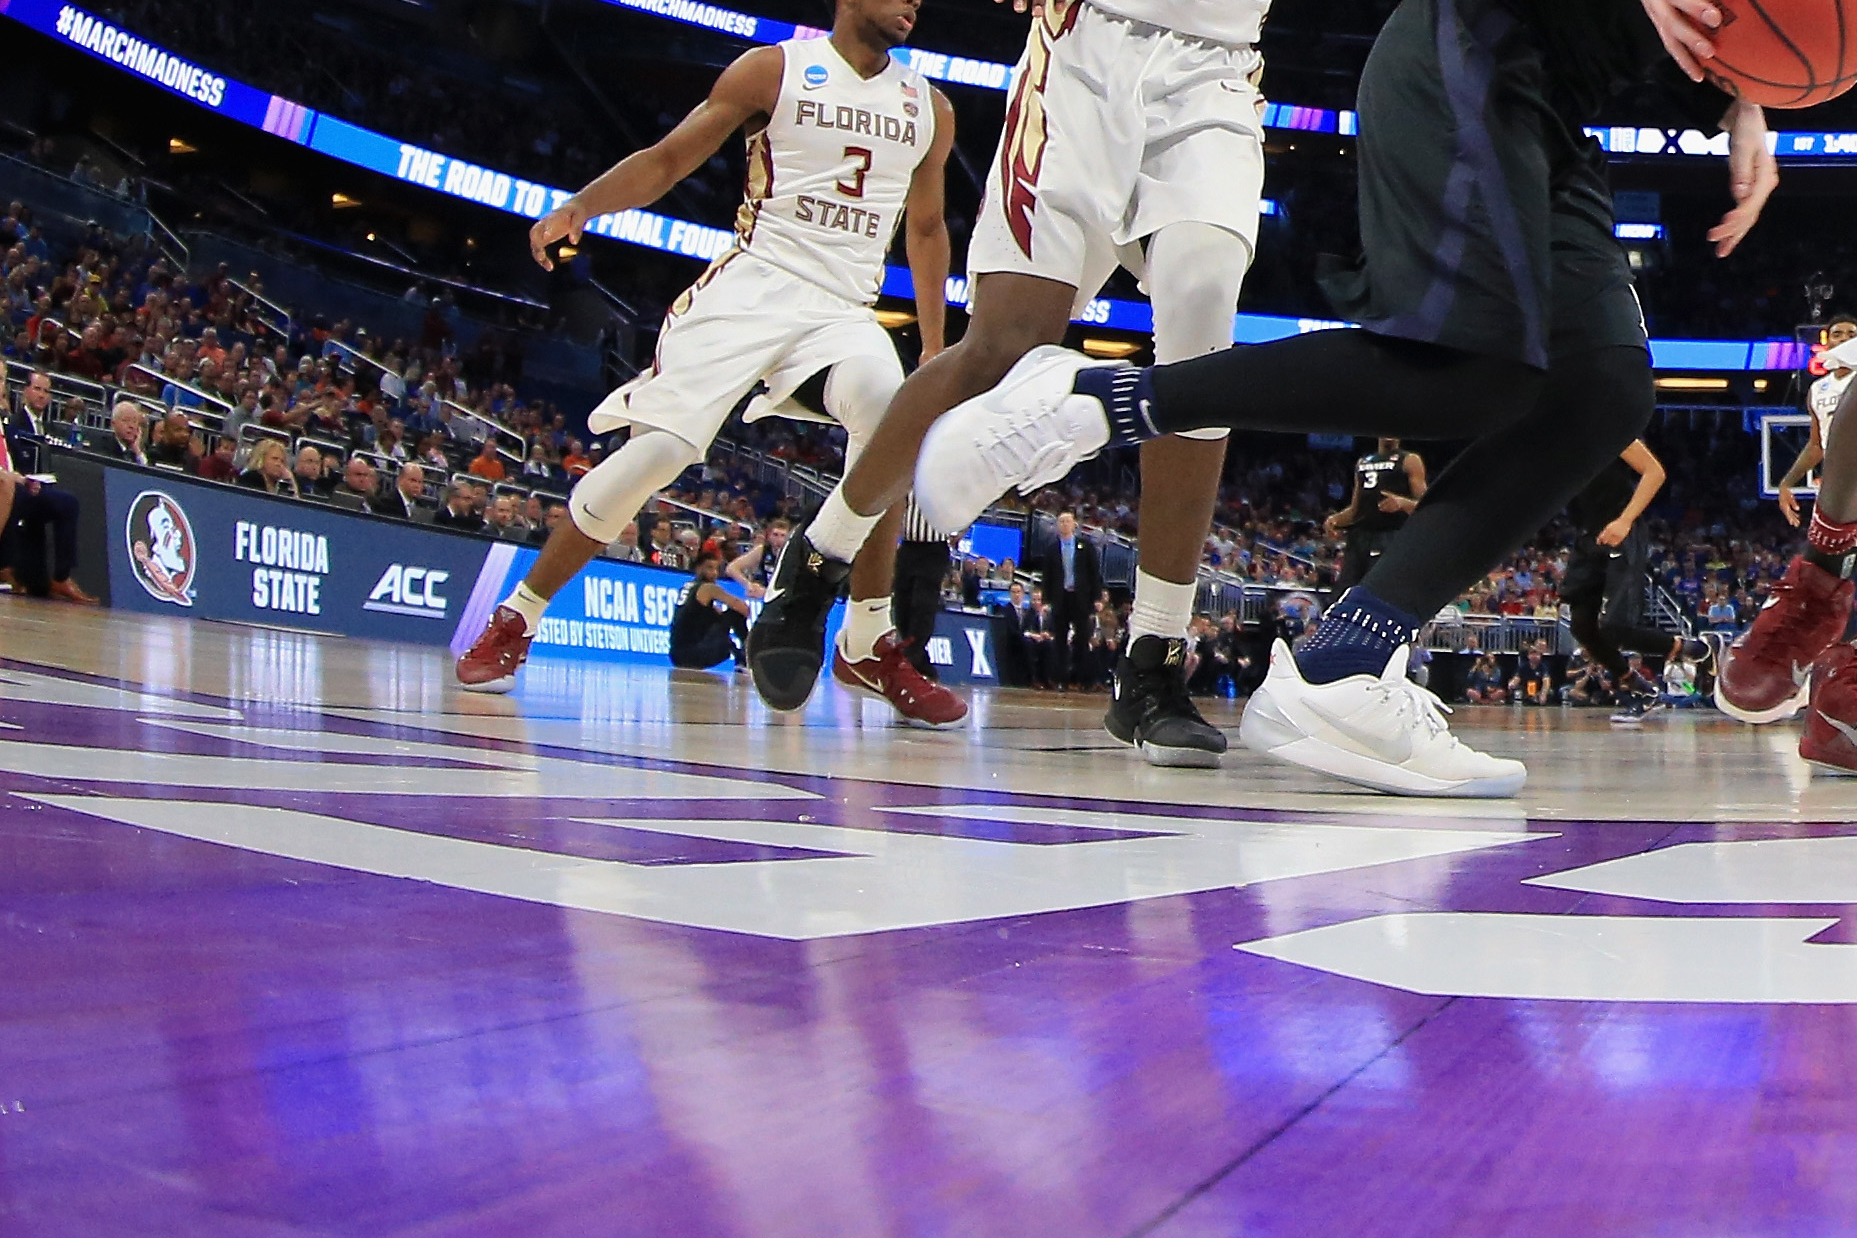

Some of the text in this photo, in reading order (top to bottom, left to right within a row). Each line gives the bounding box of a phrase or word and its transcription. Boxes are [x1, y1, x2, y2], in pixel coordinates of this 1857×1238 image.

[56, 5, 226, 108] #MARCHMADNESS
[908, 48, 1004, 89] THE ROAD
[795, 99, 917, 147] FLORIDA
[397, 144, 445, 189] THE
[444, 160, 509, 208] ROAD
[514, 177, 545, 217] TO
[834, 146, 872, 199] 3
[597, 208, 663, 248] FINAL
[794, 194, 882, 239] STATE
[1363, 471, 1379, 489] 3
[235, 521, 330, 575] FLORIDA
[252, 568, 321, 616] STATE
[369, 563, 450, 609] ACC
[584, 576, 677, 626] NCAA SEC
[535, 617, 671, 654] OSTED BY STETSON UNIVERS
[964, 629, 994, 678] X
